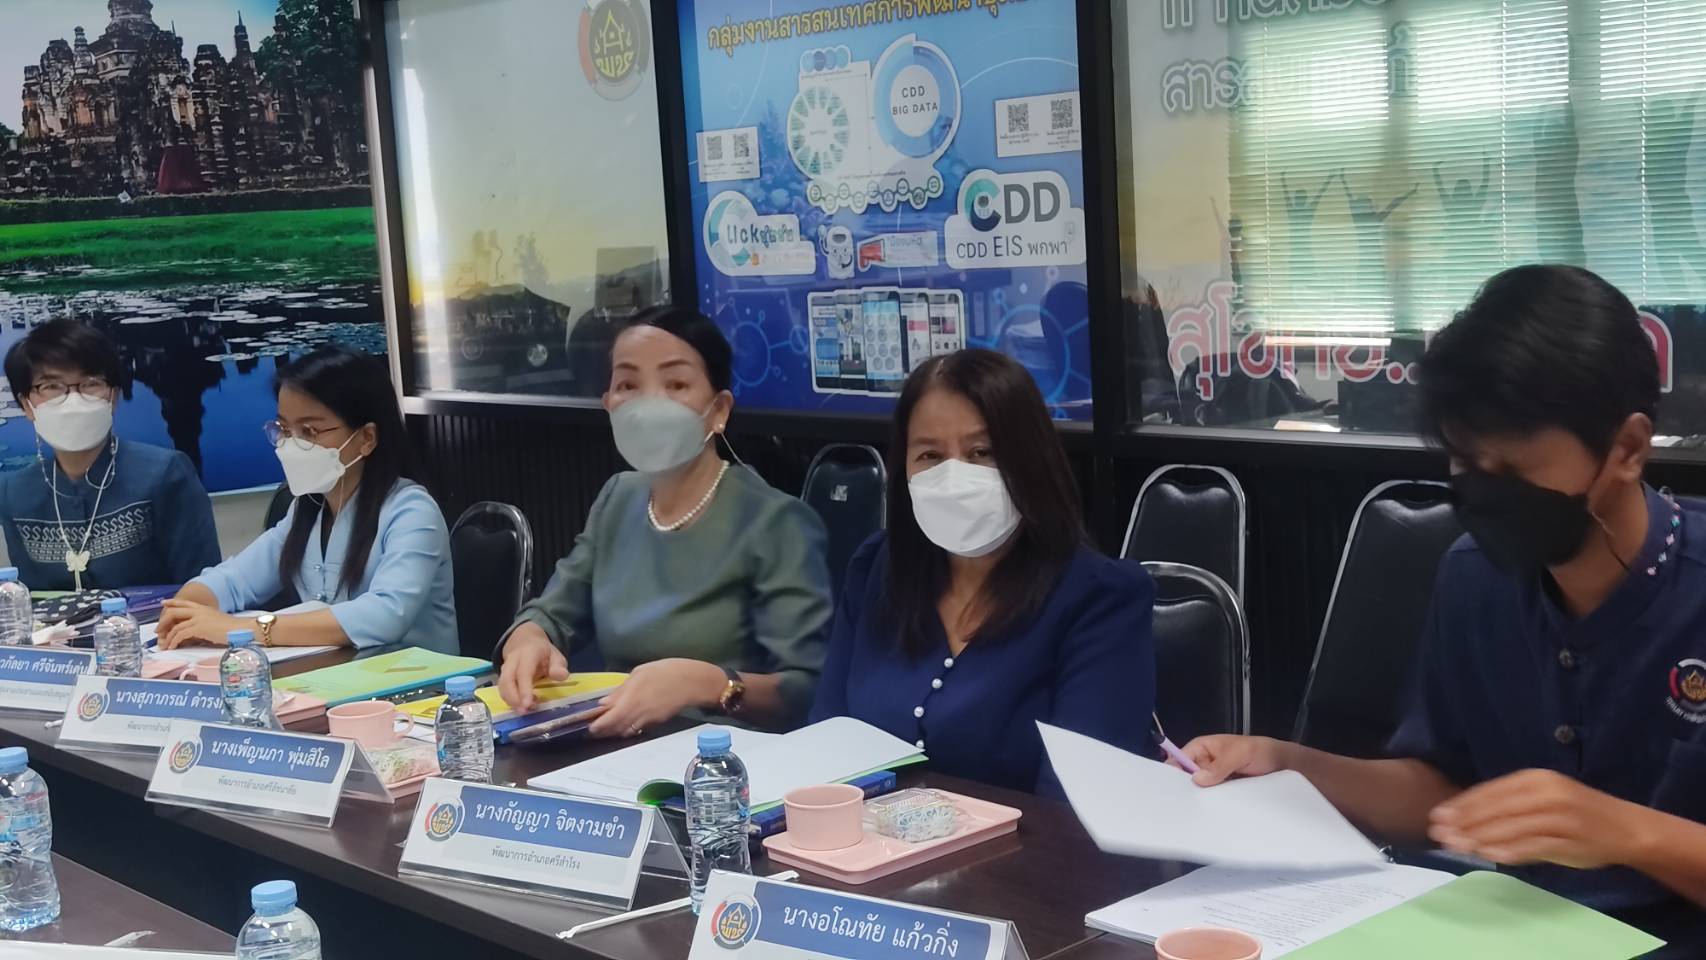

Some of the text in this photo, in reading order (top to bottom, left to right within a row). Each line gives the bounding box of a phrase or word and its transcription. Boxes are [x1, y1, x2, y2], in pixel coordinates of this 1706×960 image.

[901, 85, 925, 98] CDD
[892, 102, 938, 116] BIG DATA
[964, 178, 1061, 232] CDD
[956, 234, 1069, 259] CDD EIS พกพา
[116, 689, 191, 710] นางสุภาภรณ์
[212, 738, 284, 764] นางเพ็ญนภา
[475, 801, 626, 841] นางกัญญา จิตงามขำ
[784, 904, 959, 958] นางอโณทัย แก้วกิ่ง
